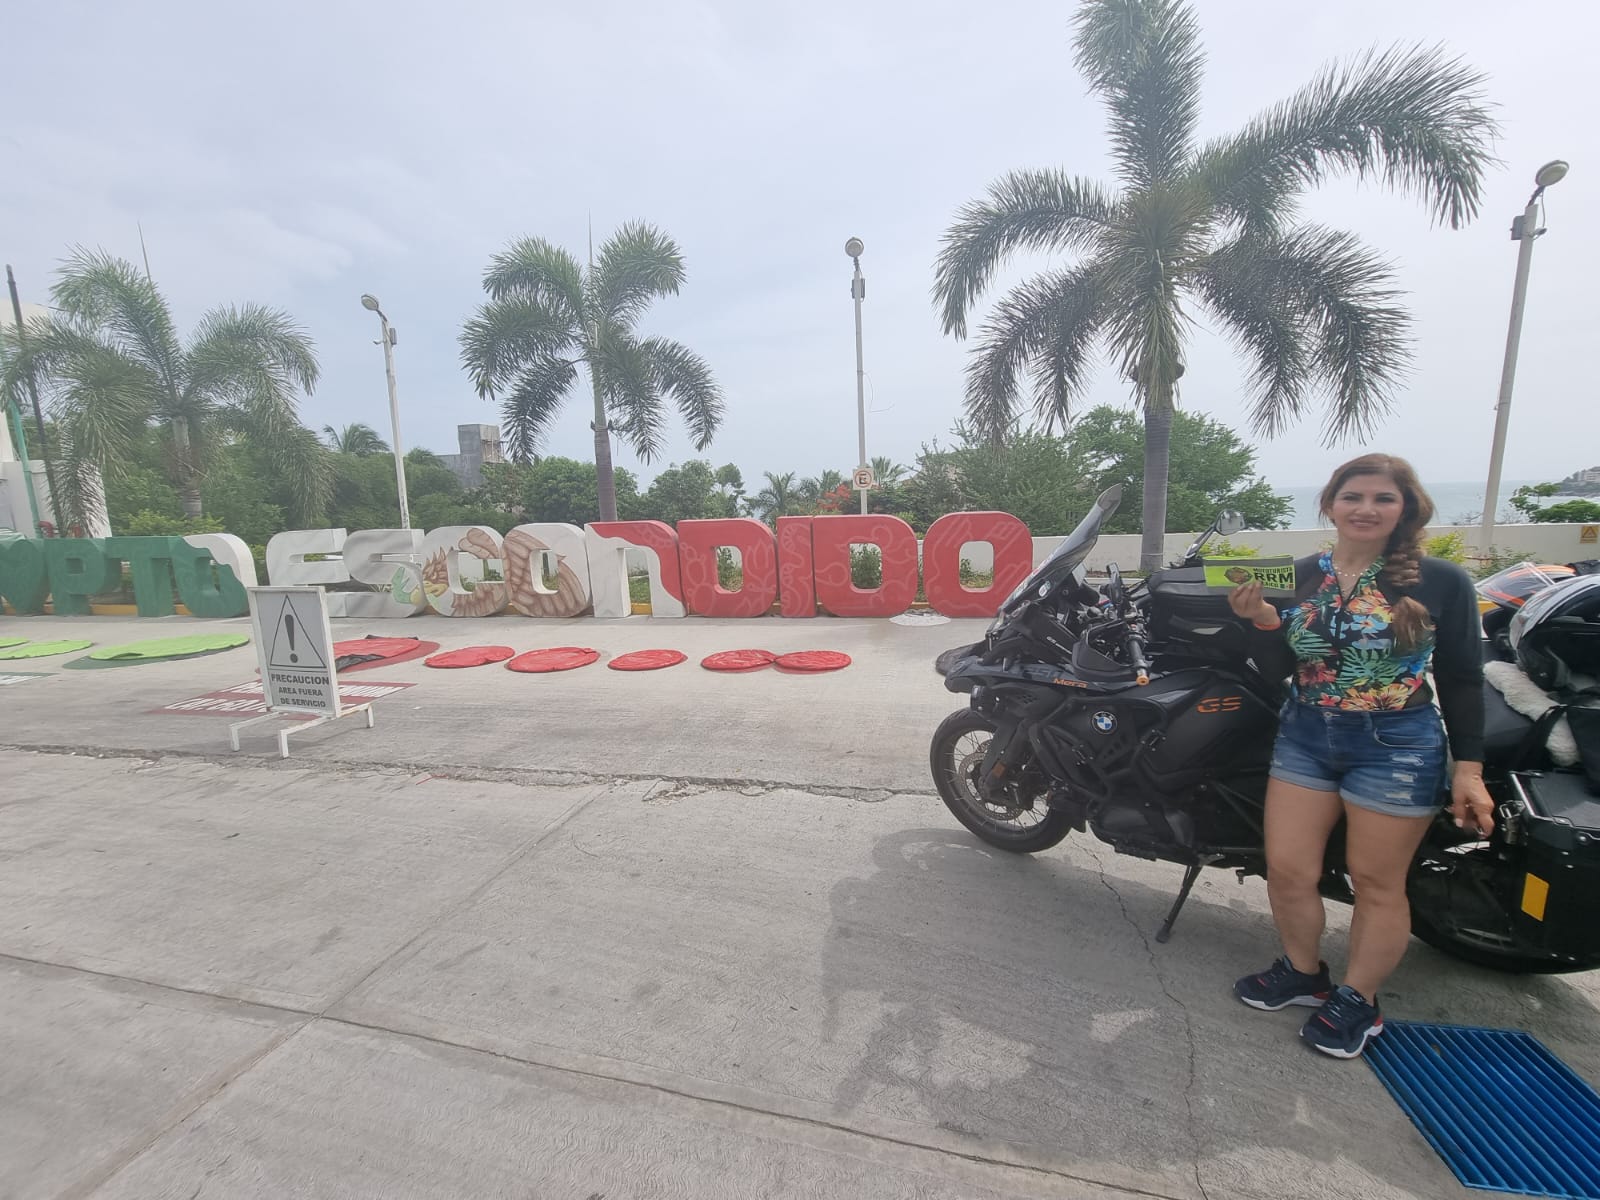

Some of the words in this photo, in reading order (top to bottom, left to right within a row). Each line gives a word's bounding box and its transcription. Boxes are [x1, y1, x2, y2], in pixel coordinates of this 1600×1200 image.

[1254, 572, 1294, 584] RRM
[271, 673, 330, 685] PRECAUCION
[278, 686, 297, 695] AREA
[298, 687, 323, 697] FUERA
[280, 697, 291, 705] DE
[291, 698, 326, 708] SERVICIO
[1197, 696, 1242, 713] GS
